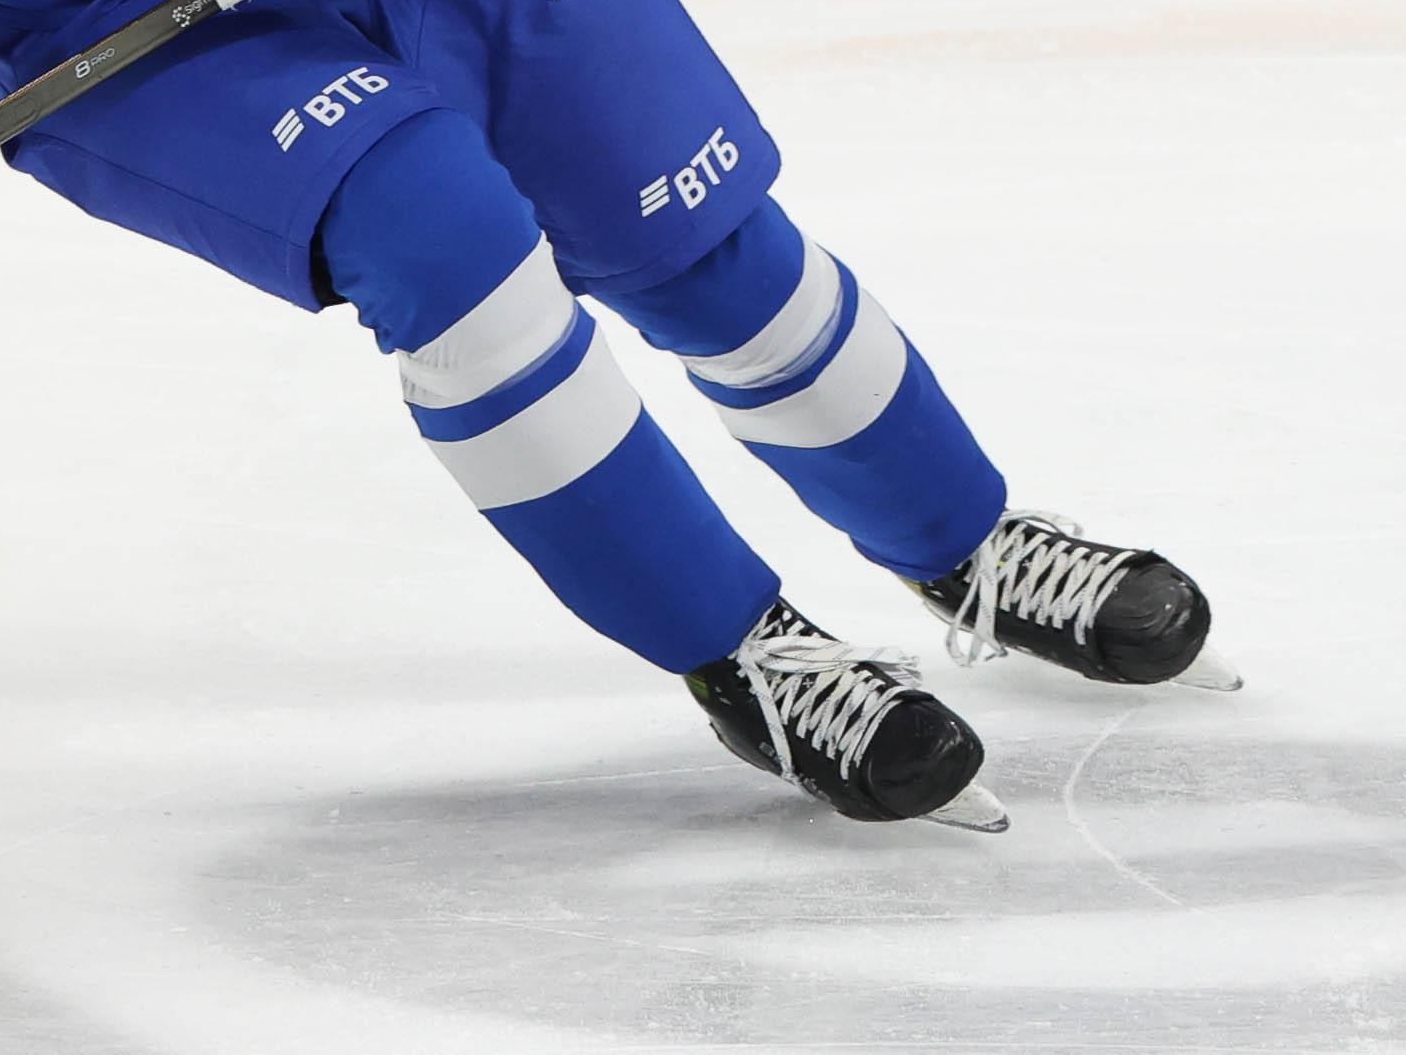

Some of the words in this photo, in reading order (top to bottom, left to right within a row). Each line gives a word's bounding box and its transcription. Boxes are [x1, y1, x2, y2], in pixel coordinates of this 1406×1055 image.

[74, 59, 91, 79] 8
[303, 66, 390, 128] ВТБ
[673, 126, 740, 211] ВТБ
